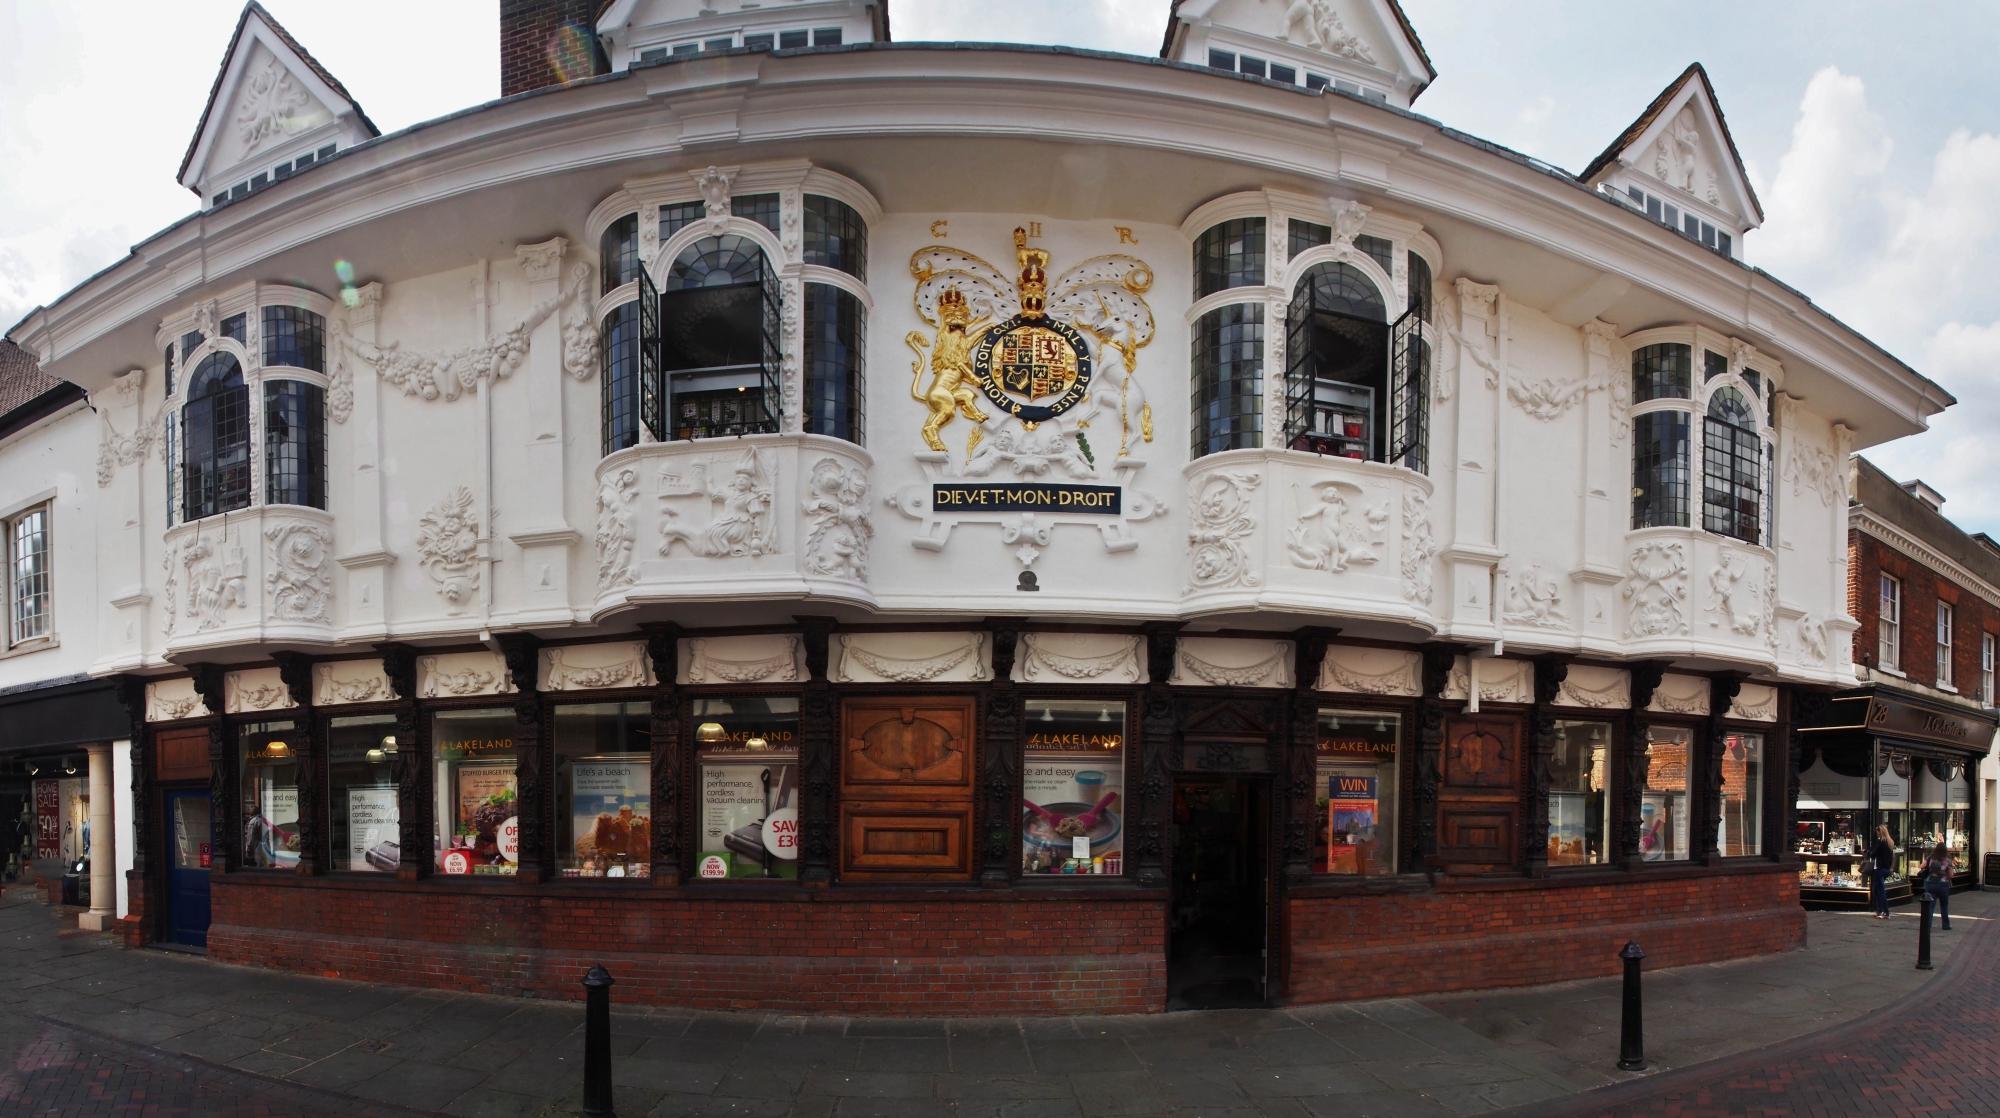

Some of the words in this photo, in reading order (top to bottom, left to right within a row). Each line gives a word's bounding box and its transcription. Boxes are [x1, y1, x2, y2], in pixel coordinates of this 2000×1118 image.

[930, 220, 948, 238] C
[1112, 225, 1139, 245] R
[1053, 320, 1081, 346] MAL
[976, 340, 992, 369] SOIT
[1078, 355, 1091, 363] Y
[981, 375, 1010, 407] HONI
[1054, 375, 1090, 414] PENSE
[1872, 703, 1888, 723] 28
[722, 730, 793, 742] AKELAND
[1043, 733, 1122, 745] LAKELAND
[449, 738, 513, 751] LAKELAND
[1333, 742, 1397, 753] LAKELAND
[577, 767, 596, 776] Life's
[605, 767, 631, 776] beach
[706, 769, 725, 779] High
[1035, 766, 1053, 776] and
[1055, 768, 1076, 780] easy
[37, 782, 58, 794] HOME
[1339, 778, 1368, 792] WIN
[284, 793, 298, 804] easy
[351, 794, 366, 803] High
[706, 788, 734, 797] cordless
[37, 794, 59, 808] SALE
[351, 810, 373, 818] cordless
[771, 819, 799, 834] SAV
